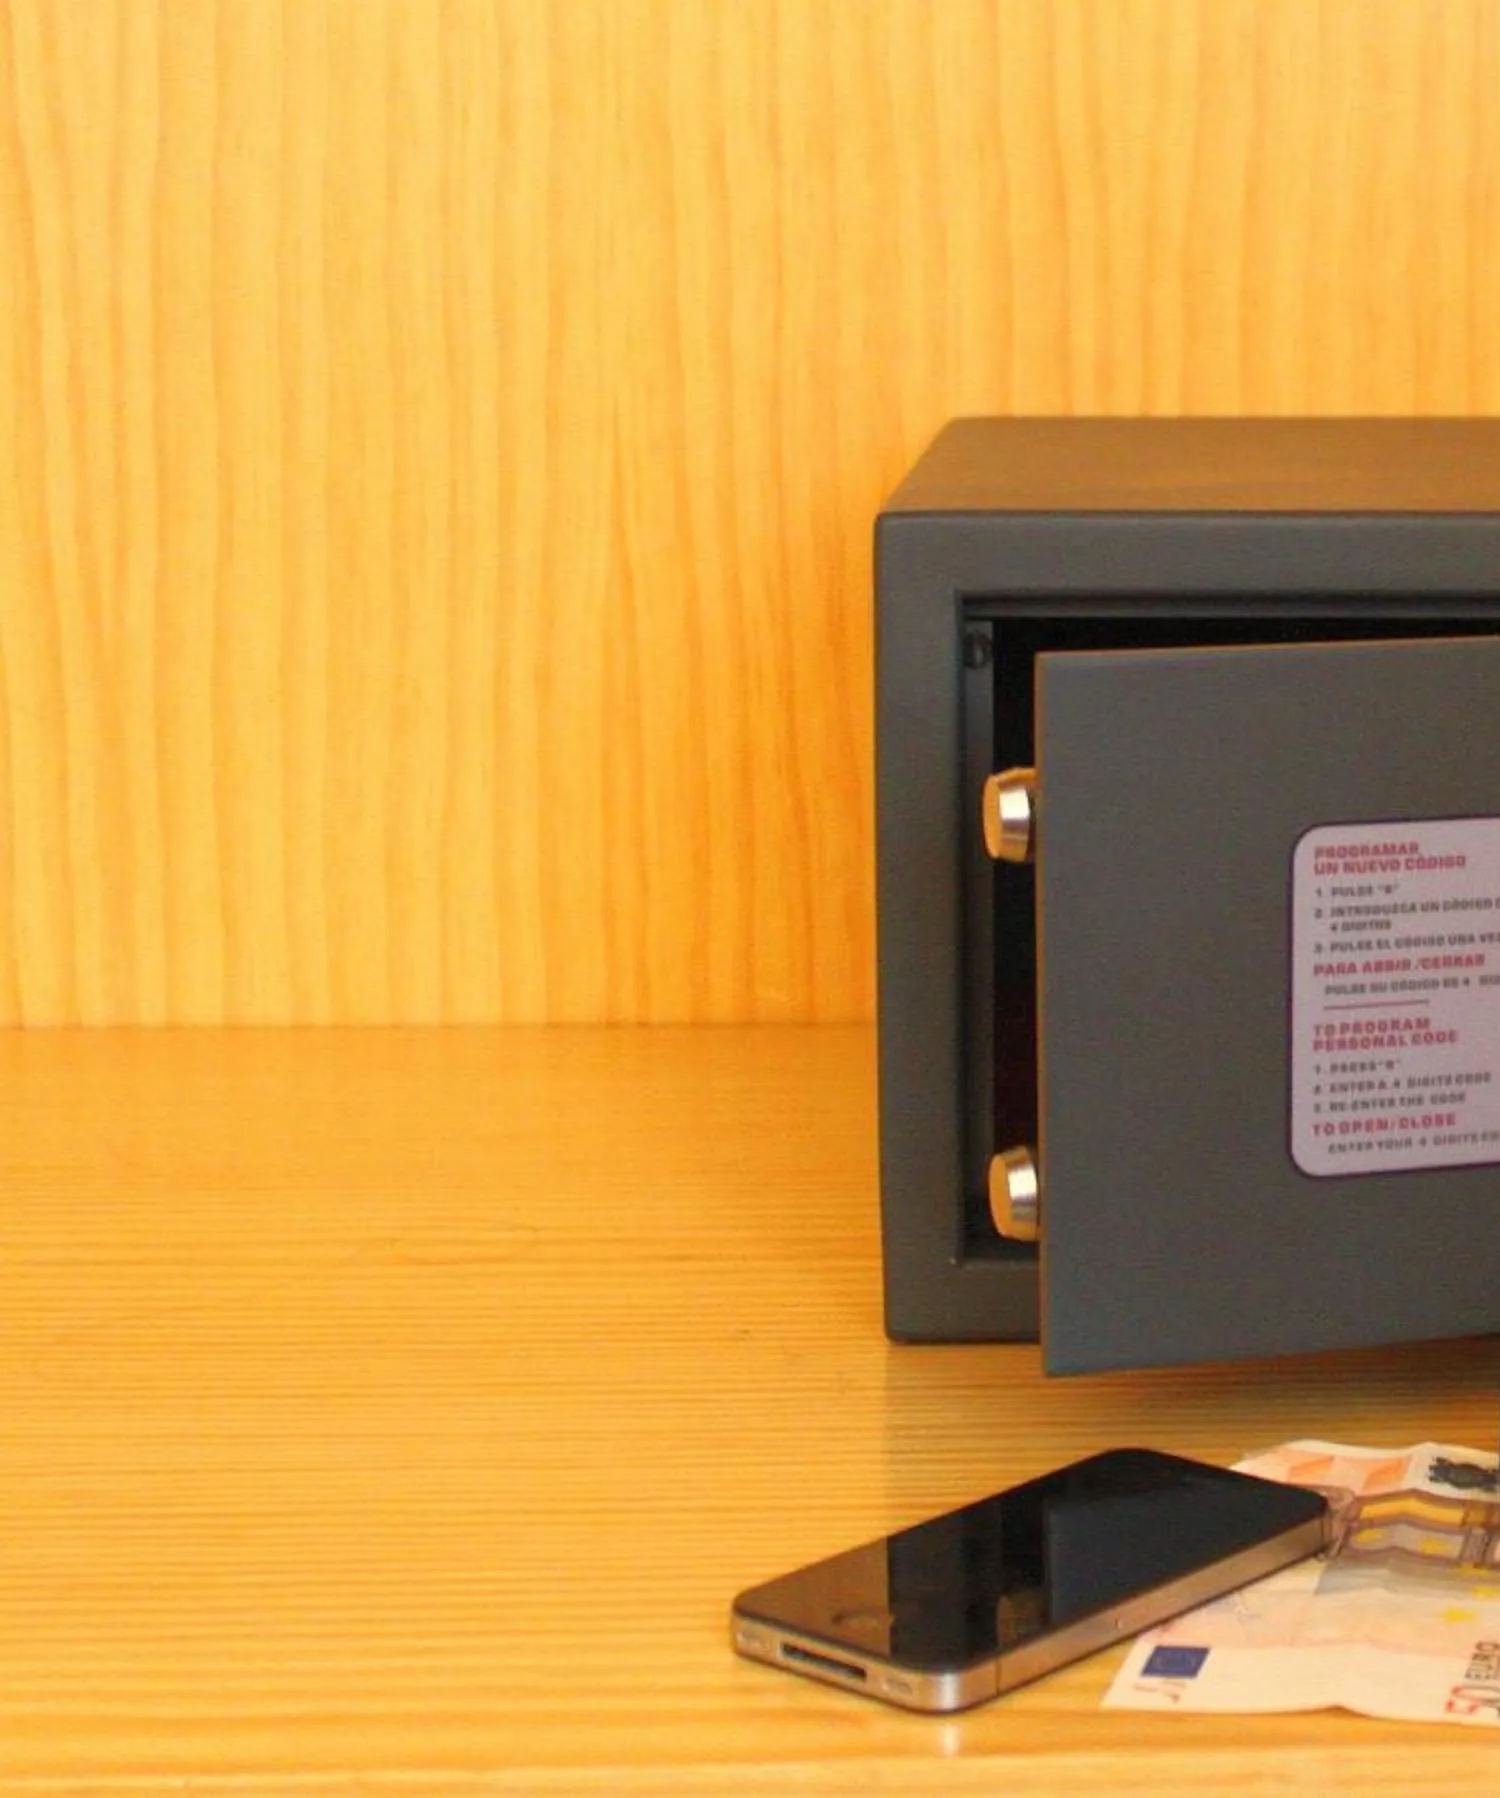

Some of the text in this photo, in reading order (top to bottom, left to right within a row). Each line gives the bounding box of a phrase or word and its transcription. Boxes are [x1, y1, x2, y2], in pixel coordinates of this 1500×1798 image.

[1314, 841, 1419, 859] PROGRAMAR
[1313, 862, 1338, 875] UN
[1343, 859, 1401, 874] NUEVO
[1313, 962, 1357, 977] PARA
[1314, 1017, 1431, 1036] TO PROGRAM
[1313, 1029, 1459, 1052] PERSONAL CODE
[1313, 1122, 1335, 1137] TO
[1464, 1641, 1500, 1679] EURO
